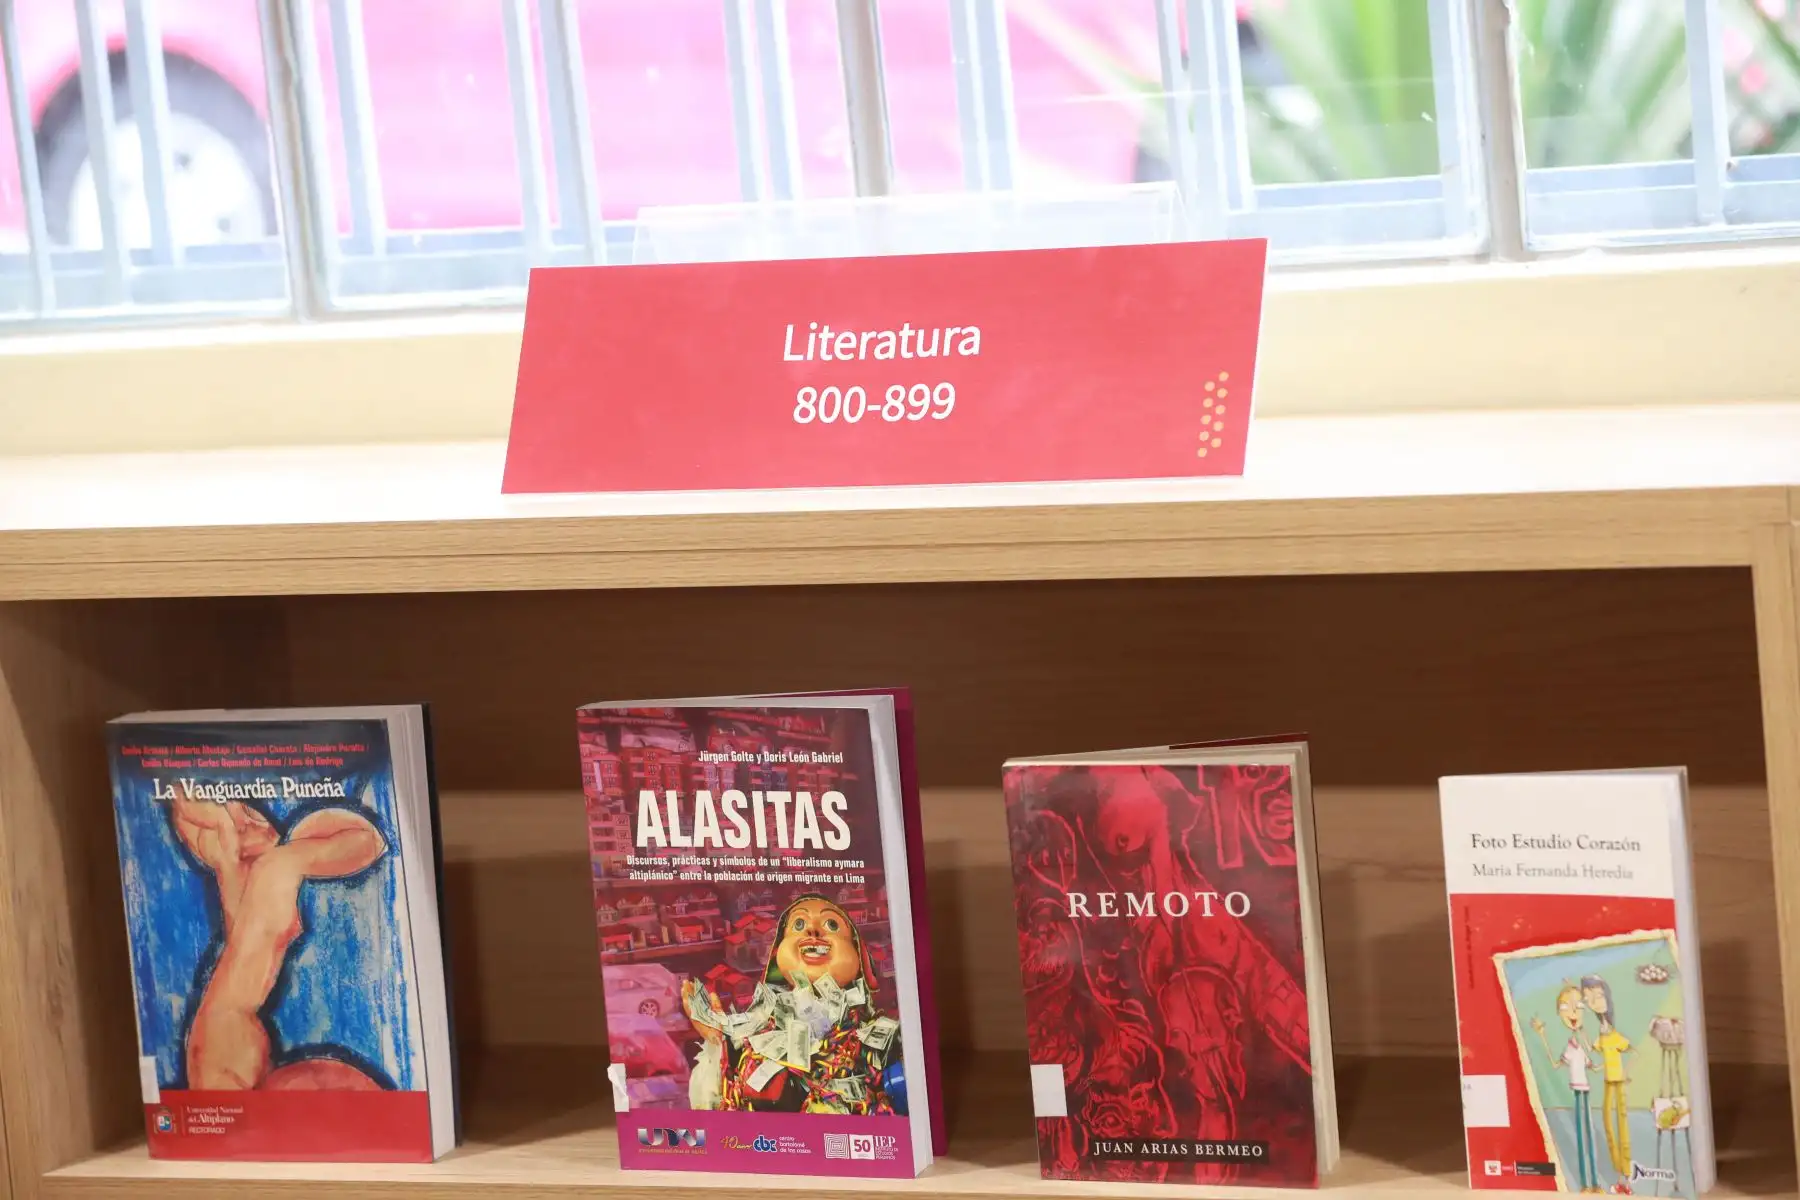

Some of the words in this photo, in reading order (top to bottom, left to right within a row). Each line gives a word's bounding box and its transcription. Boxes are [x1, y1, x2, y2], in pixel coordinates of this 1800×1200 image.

[783, 321, 981, 362] Literatura
[792, 381, 956, 424] 800-899
[698, 750, 729, 764] Jürgen
[730, 750, 754, 762] Golte
[756, 753, 762, 764] y
[763, 751, 787, 763] Doris
[788, 750, 810, 763] León
[811, 751, 844, 764] Gabriel
[152, 777, 177, 800] La
[179, 776, 278, 804] Vanguardia
[281, 776, 346, 799] Puneña
[636, 788, 852, 851] ALASITAS
[1470, 832, 1508, 851] Foto
[1511, 832, 1573, 851] Estudio
[1575, 833, 1642, 852] Corazón
[626, 854, 671, 867] Discursos,
[671, 855, 711, 868] prácticas
[712, 857, 718, 868] y
[719, 854, 757, 867] símbolos
[758, 856, 769, 867] de
[770, 858, 781, 867] un
[834, 859, 865, 870] aymara
[1515, 862, 1579, 879] Fernanda
[1581, 863, 1634, 880] Heredia
[679, 870, 702, 881] entre
[703, 870, 712, 881] la
[713, 869, 753, 883] población
[754, 871, 765, 882] de
[766, 872, 793, 885] origen
[794, 872, 832, 885] migrante
[833, 875, 844, 884] en
[845, 873, 865, 884] Lima
[1066, 891, 1251, 918] REMOTO
[853, 1139, 871, 1153] 50
[874, 1135, 896, 1147] IEP
[1093, 1141, 1134, 1156] JUAN
[1140, 1142, 1188, 1155] ARIAS
[1195, 1143, 1264, 1157] BERMEO
[1631, 1163, 1675, 1181] Norma
